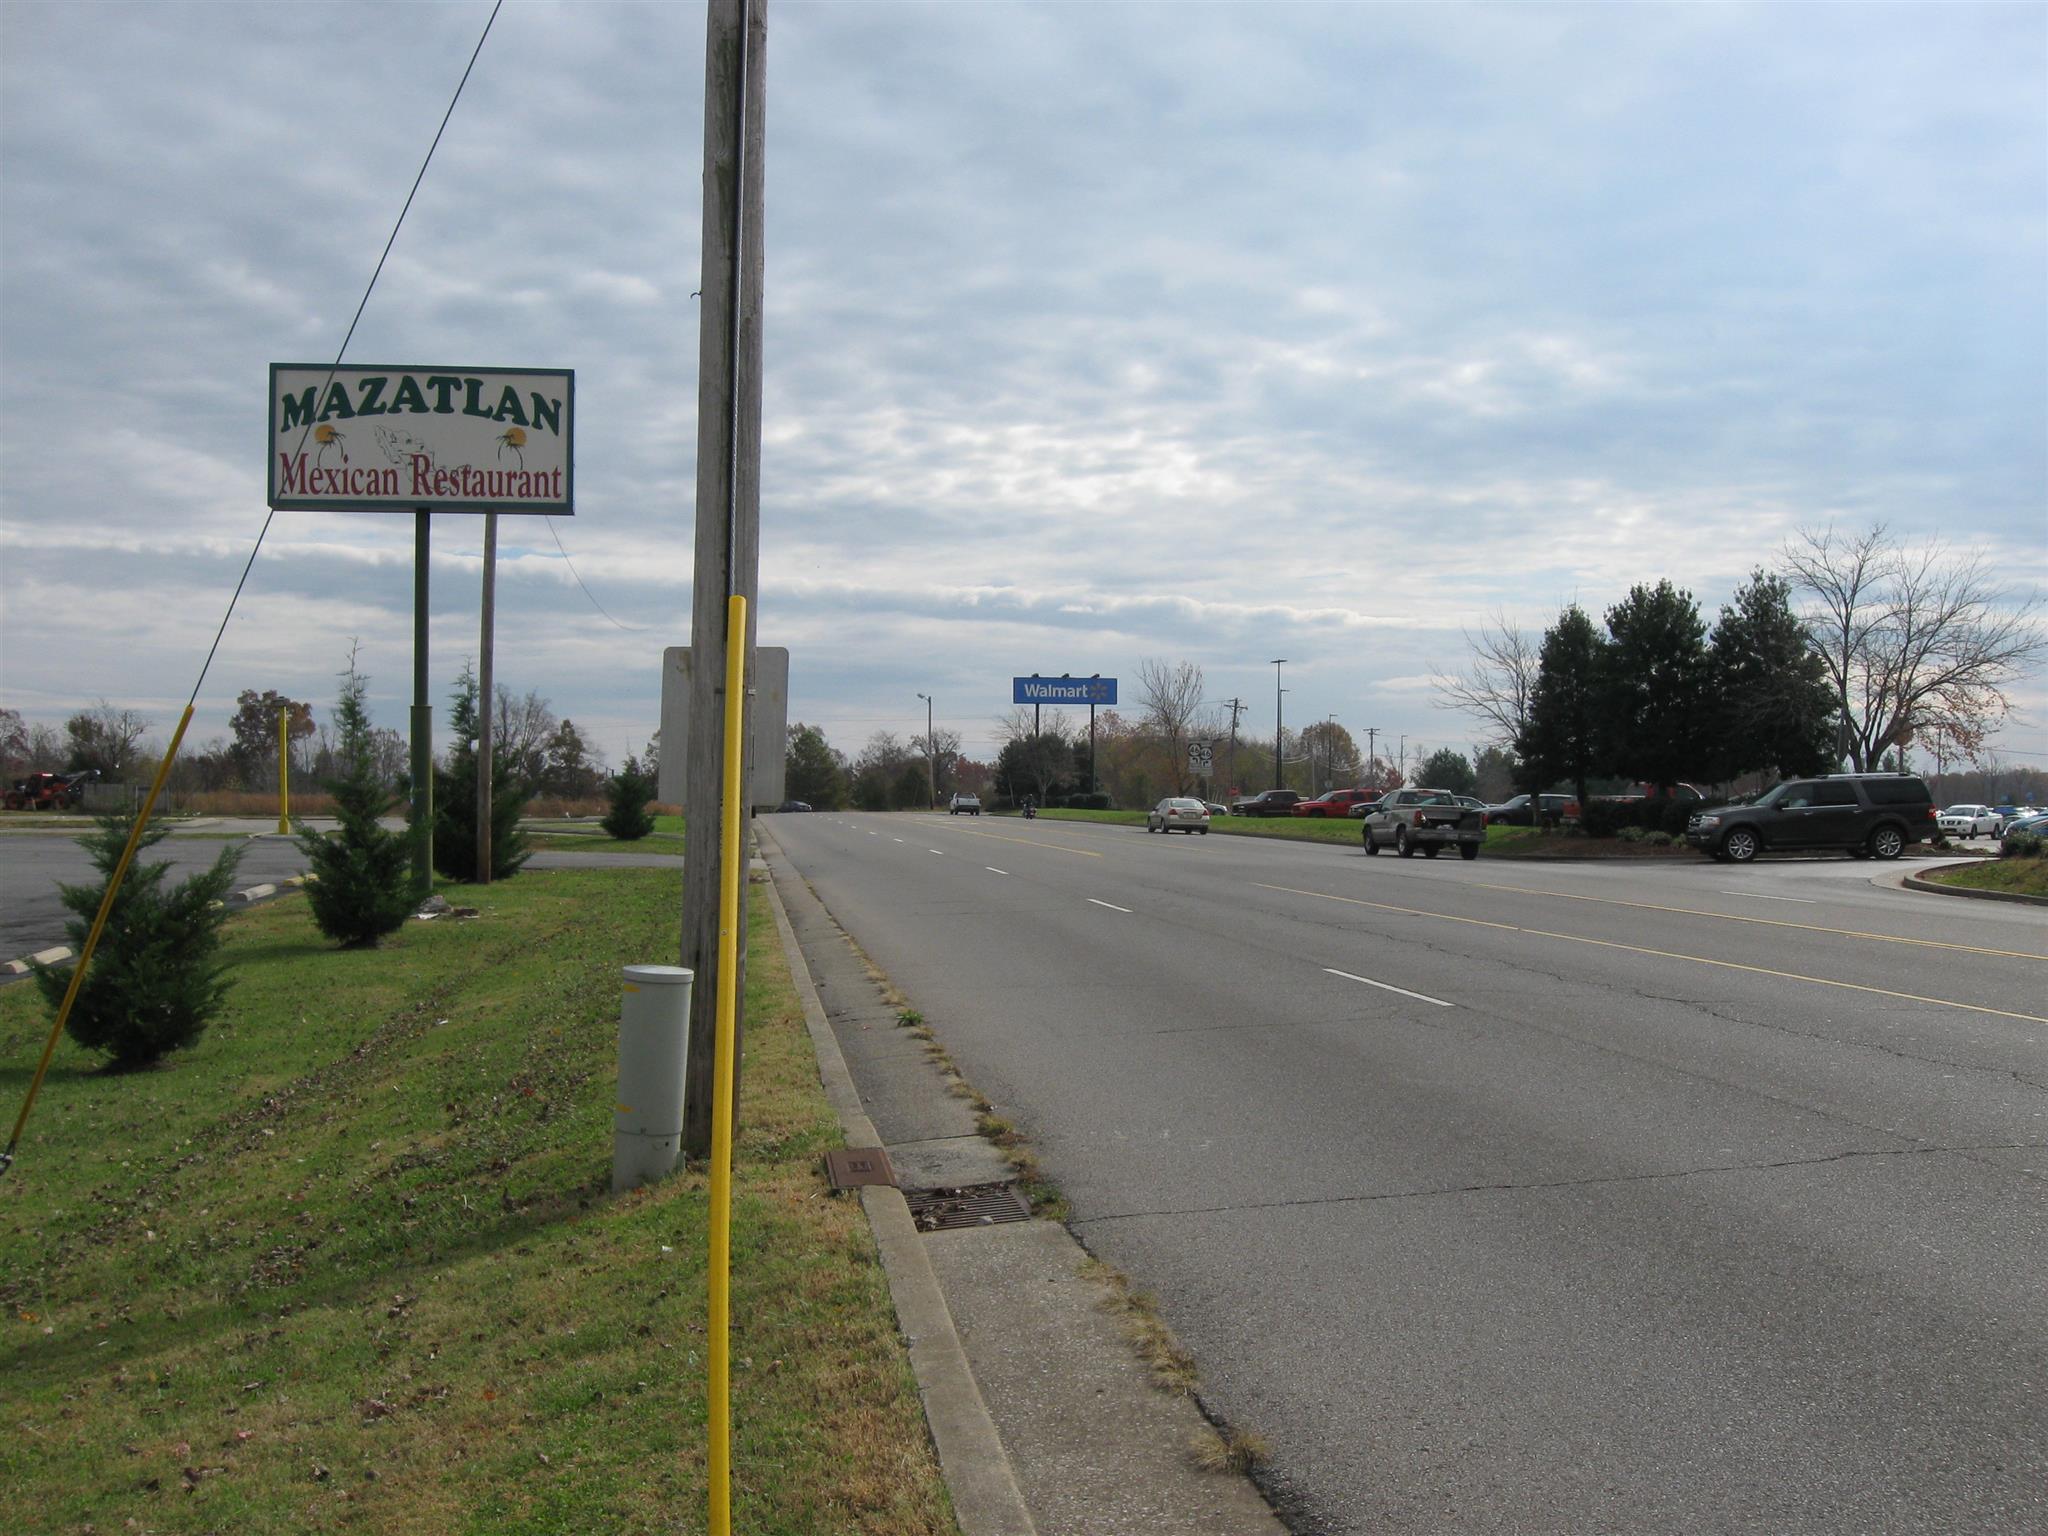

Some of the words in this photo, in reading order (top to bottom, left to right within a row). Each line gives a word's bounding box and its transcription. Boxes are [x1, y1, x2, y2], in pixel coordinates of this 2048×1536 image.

[281, 375, 562, 436] MAZATLAN
[279, 452, 400, 498] Mexican
[411, 454, 562, 499] Restaurant
[1024, 683, 1088, 698] Walmart
